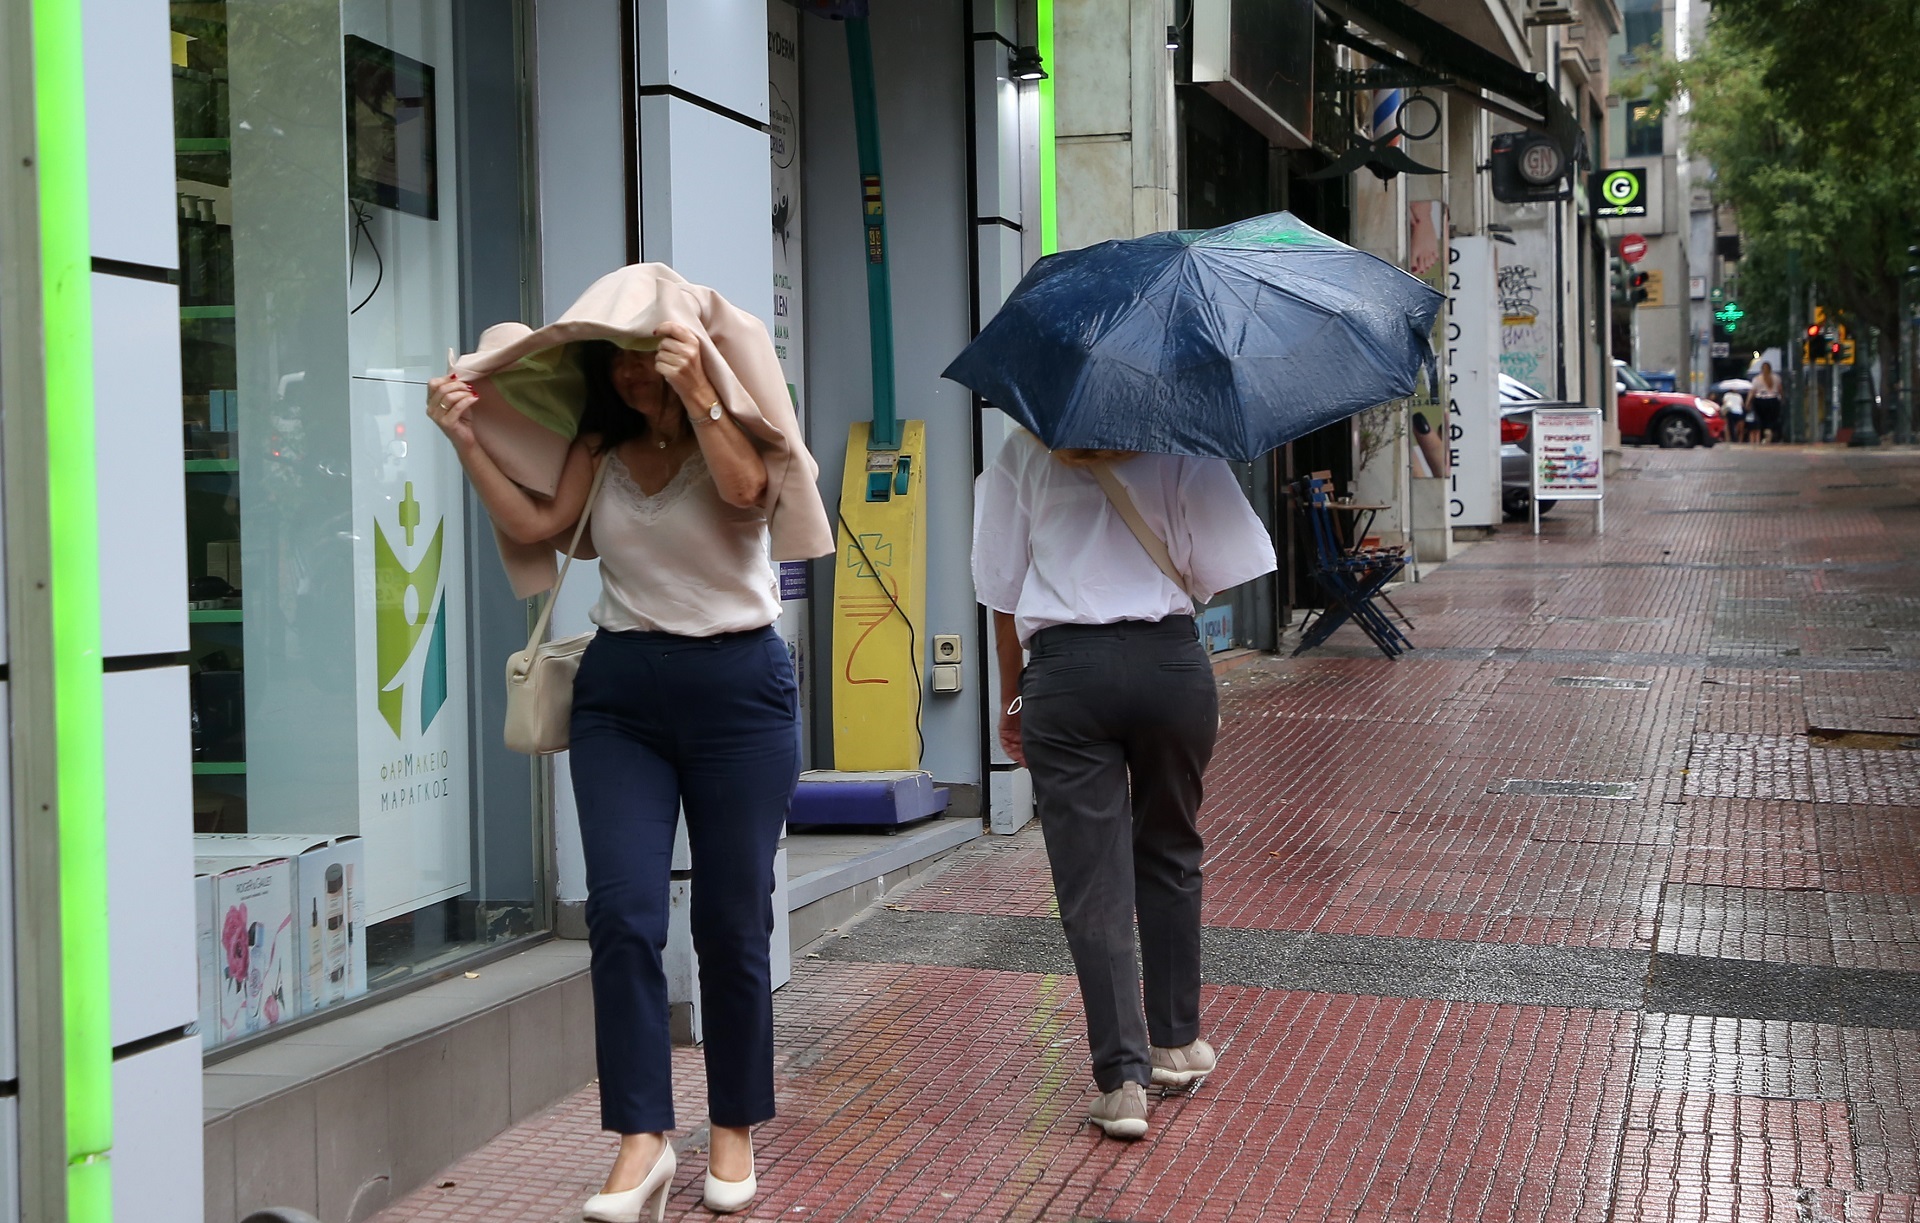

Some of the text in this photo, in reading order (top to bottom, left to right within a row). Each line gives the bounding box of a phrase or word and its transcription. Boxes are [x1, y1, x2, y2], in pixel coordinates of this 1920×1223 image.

[768, 30, 795, 62] ZYDERM
[1611, 177, 1631, 198] G
[380, 749, 449, 782] ΦΑΡΜΑΚΕΙΟ
[381, 778, 449, 812] ΜΑΡΑΓΚΟΣ
